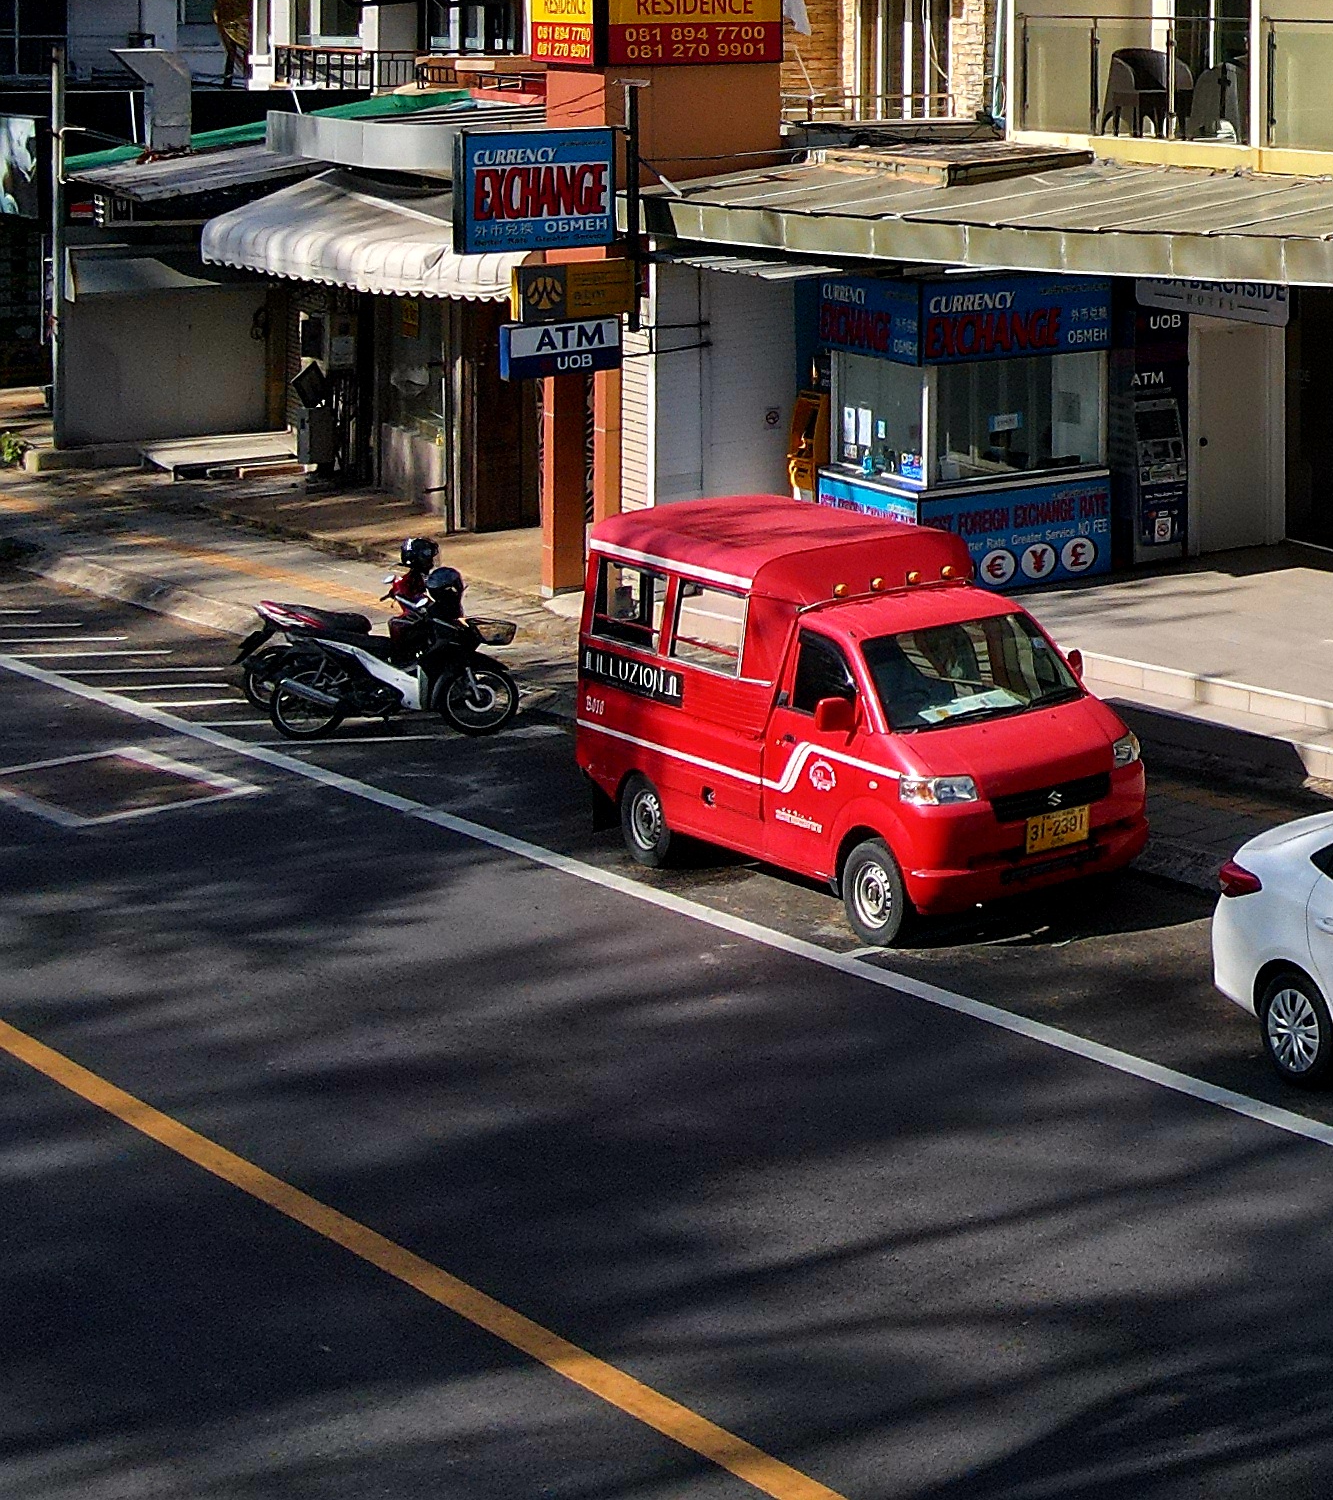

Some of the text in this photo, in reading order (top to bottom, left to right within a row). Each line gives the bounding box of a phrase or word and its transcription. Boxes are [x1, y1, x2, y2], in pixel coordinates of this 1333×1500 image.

[625, 26, 766, 42] 081 894 7700
[554, 42, 569, 57] 270
[626, 42, 765, 58] 081 270 9901
[473, 147, 557, 165] CURRENCY
[473, 163, 608, 222] EXCHANGE
[544, 217, 609, 234] ОБМЕН
[822, 283, 867, 305] CURRENCY
[929, 291, 1017, 314] CURRENCY
[820, 302, 891, 352] EXCHANGE
[1150, 314, 1182, 329] UOB
[535, 323, 605, 353] ATM
[923, 307, 1063, 359] EXCHANGE
[1067, 328, 1108, 344] ОБМЕН
[557, 353, 593, 370] UOB
[1130, 371, 1165, 387] ATM
[957, 507, 1009, 535] FOREIGN
[1013, 499, 1075, 529] EXCHANGE
[1079, 492, 1110, 517] RATE
[986, 538, 1006, 549] Rate
[1011, 533, 1042, 546] Greater
[1045, 528, 1075, 540] Service
[1078, 521, 1090, 536] NO
[1093, 518, 1108, 533] FEE
[987, 542, 1087, 579] € ¥ £
[595, 653, 666, 697] ILLUZION
